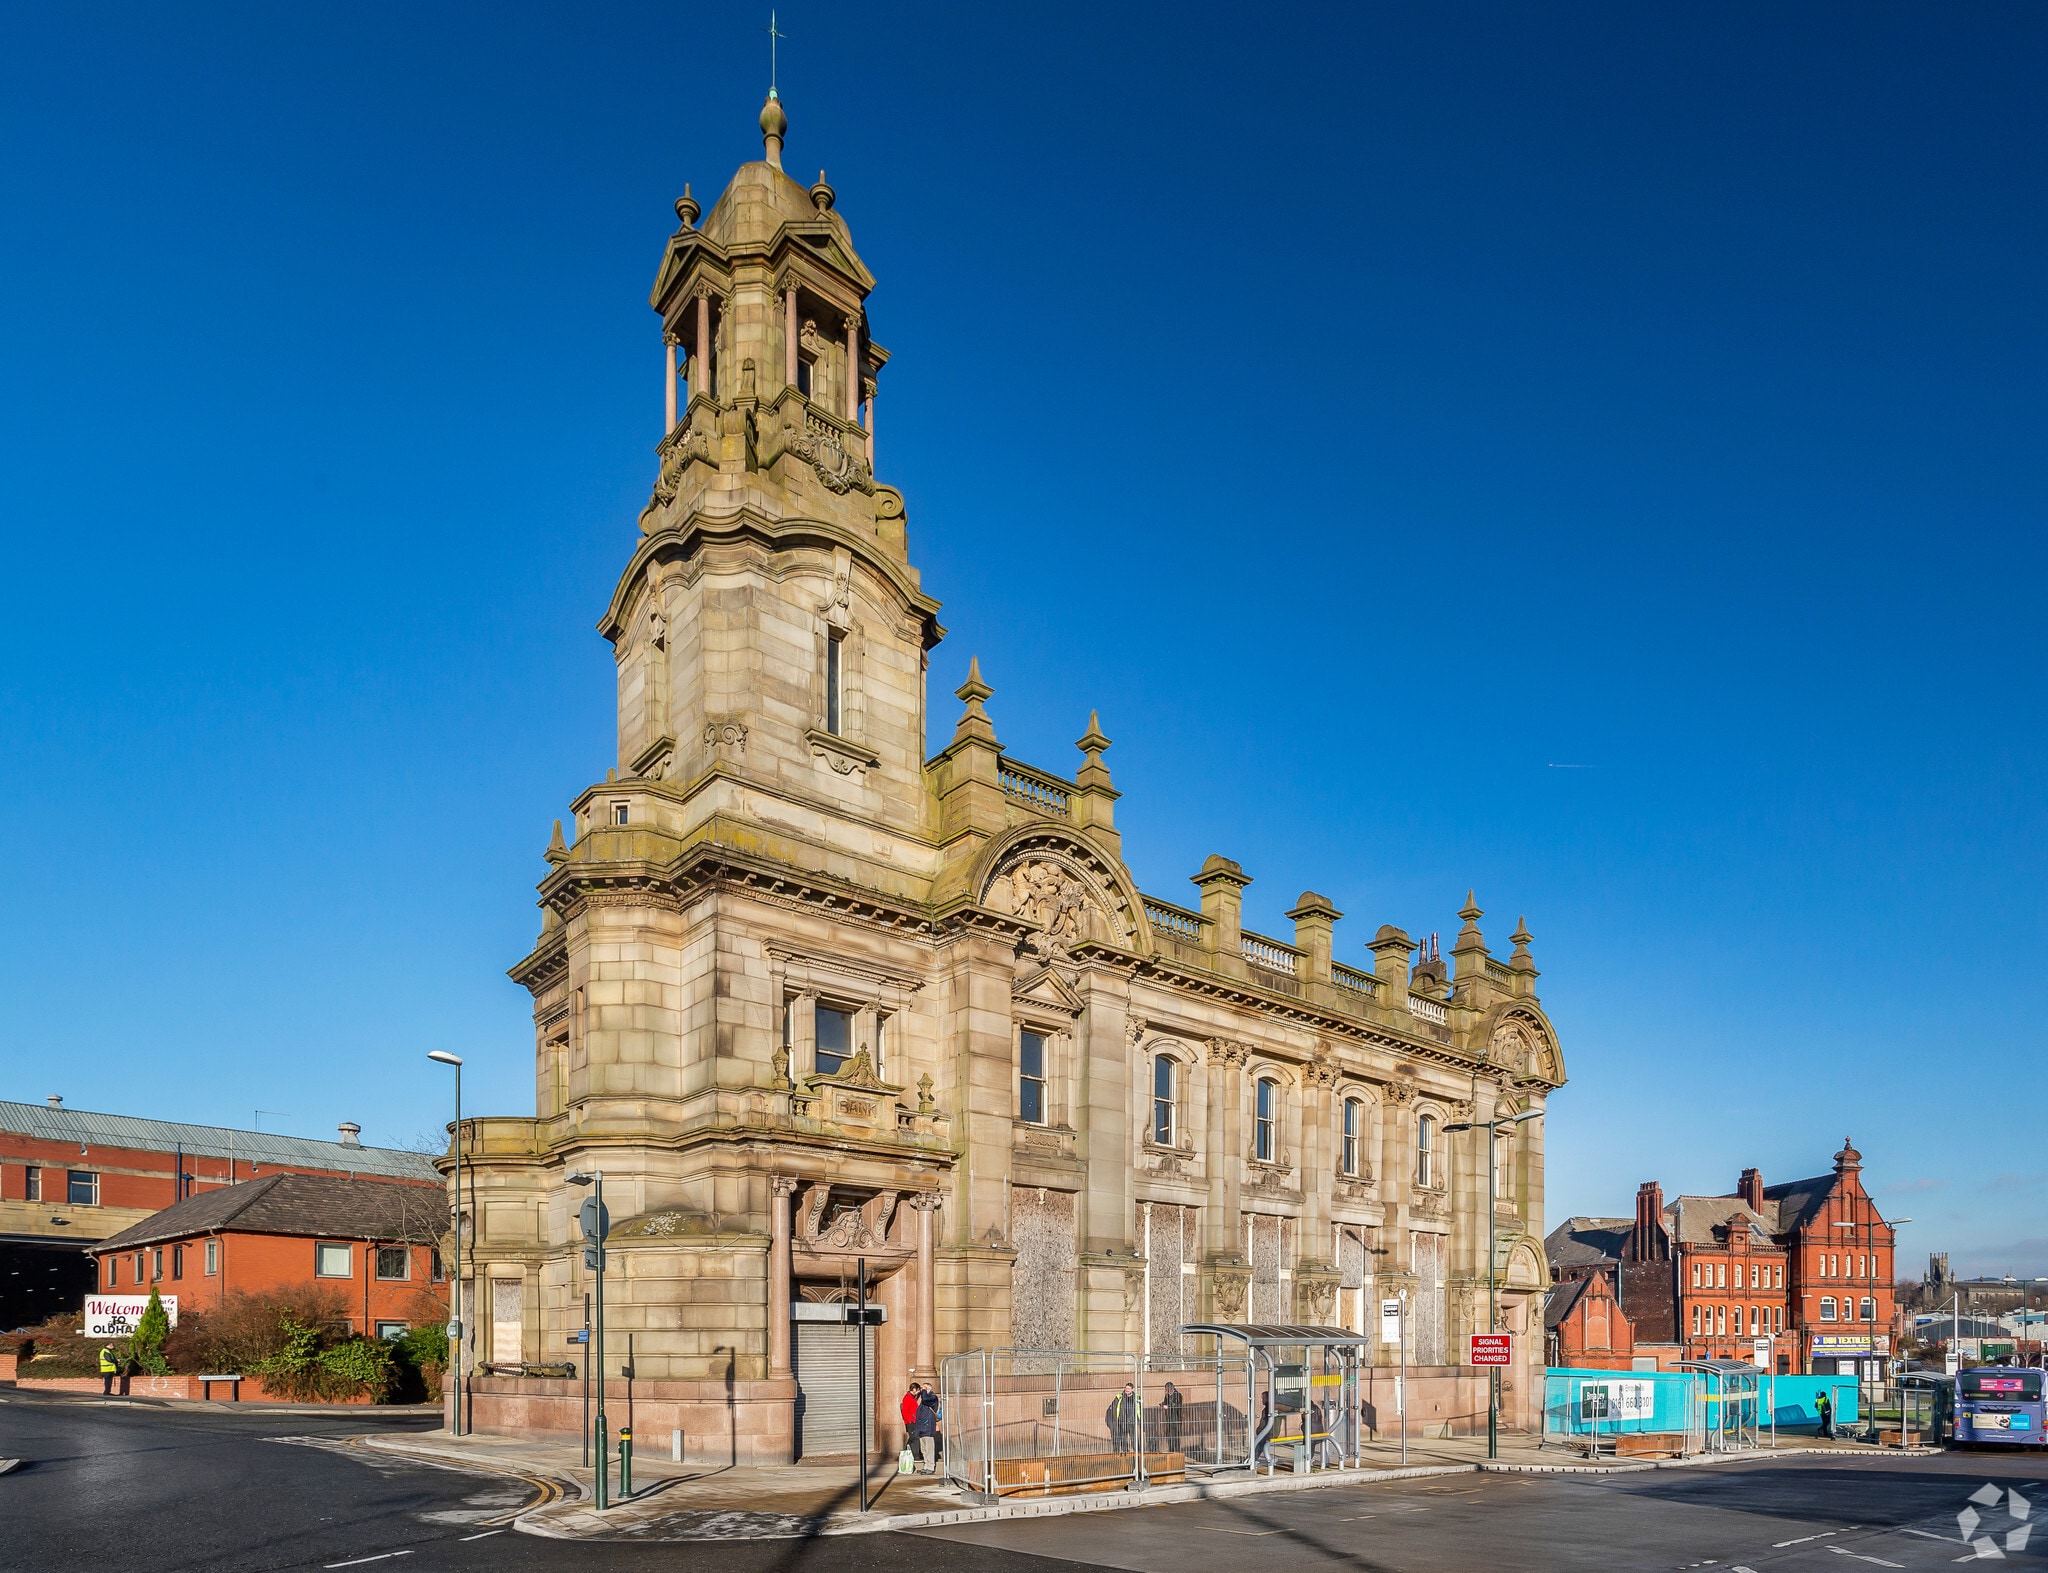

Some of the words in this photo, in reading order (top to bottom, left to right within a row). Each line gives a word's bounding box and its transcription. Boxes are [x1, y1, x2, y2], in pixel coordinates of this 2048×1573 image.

[839, 1100, 877, 1117] BANK
[87, 1301, 145, 1315] Welcom
[111, 1316, 126, 1325] TO
[1838, 1336, 1871, 1344] TEXTILES
[1472, 1346, 1509, 1354] PRIORITIES
